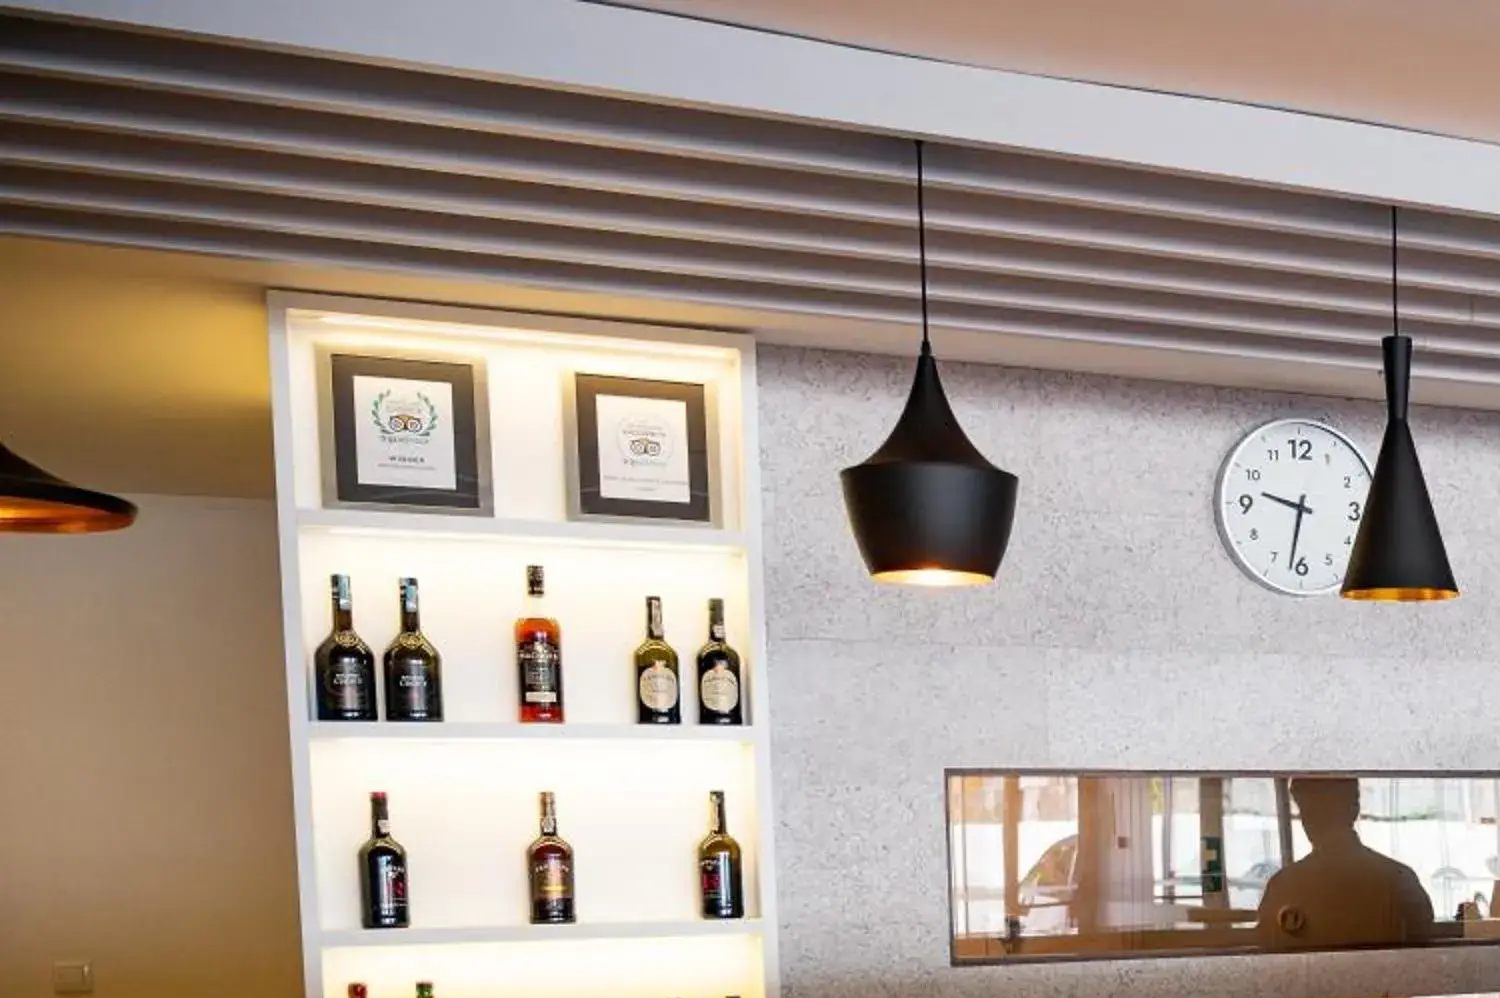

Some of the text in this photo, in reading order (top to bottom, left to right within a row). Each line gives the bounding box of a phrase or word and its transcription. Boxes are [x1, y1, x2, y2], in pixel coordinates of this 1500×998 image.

[1267, 449, 1279, 461] 11
[1288, 439, 1312, 461] 12
[1324, 453, 1331, 465] 1
[1246, 469, 1261, 481] 10
[1343, 476, 1351, 488] 2
[1239, 494, 1253, 515] 9
[1348, 501, 1360, 521] 3
[1249, 528, 1259, 541] 8
[1343, 536, 1351, 546] 4
[1270, 551, 1278, 563] 7
[1324, 554, 1333, 566] 5
[1295, 557, 1309, 577] 6
